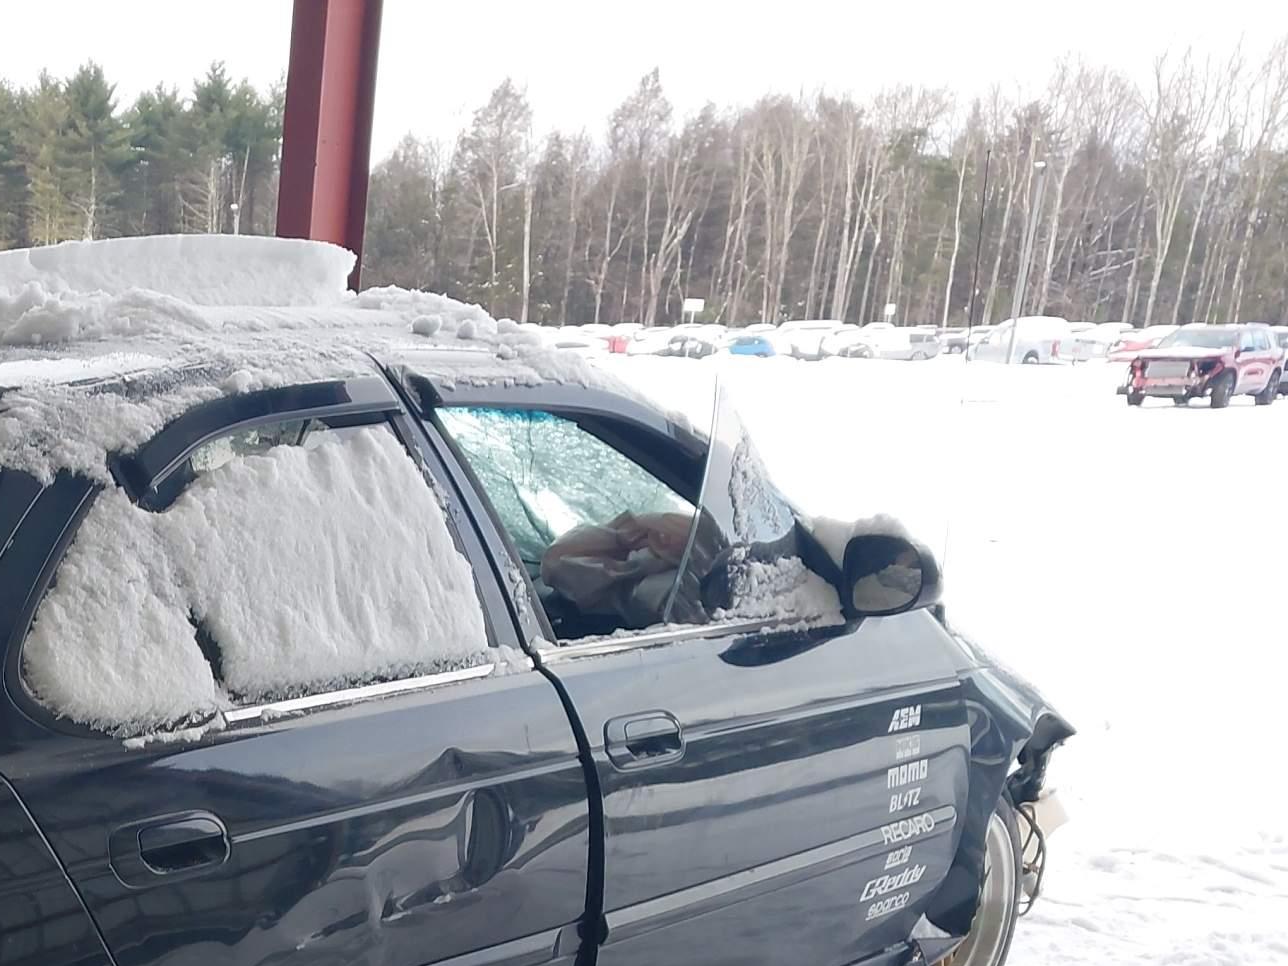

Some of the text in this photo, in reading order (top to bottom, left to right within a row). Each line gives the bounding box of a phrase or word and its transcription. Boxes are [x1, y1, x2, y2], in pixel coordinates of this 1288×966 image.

[887, 704, 922, 733] AEM
[889, 787, 921, 813] BLITZ
[880, 813, 935, 845] RECARO
